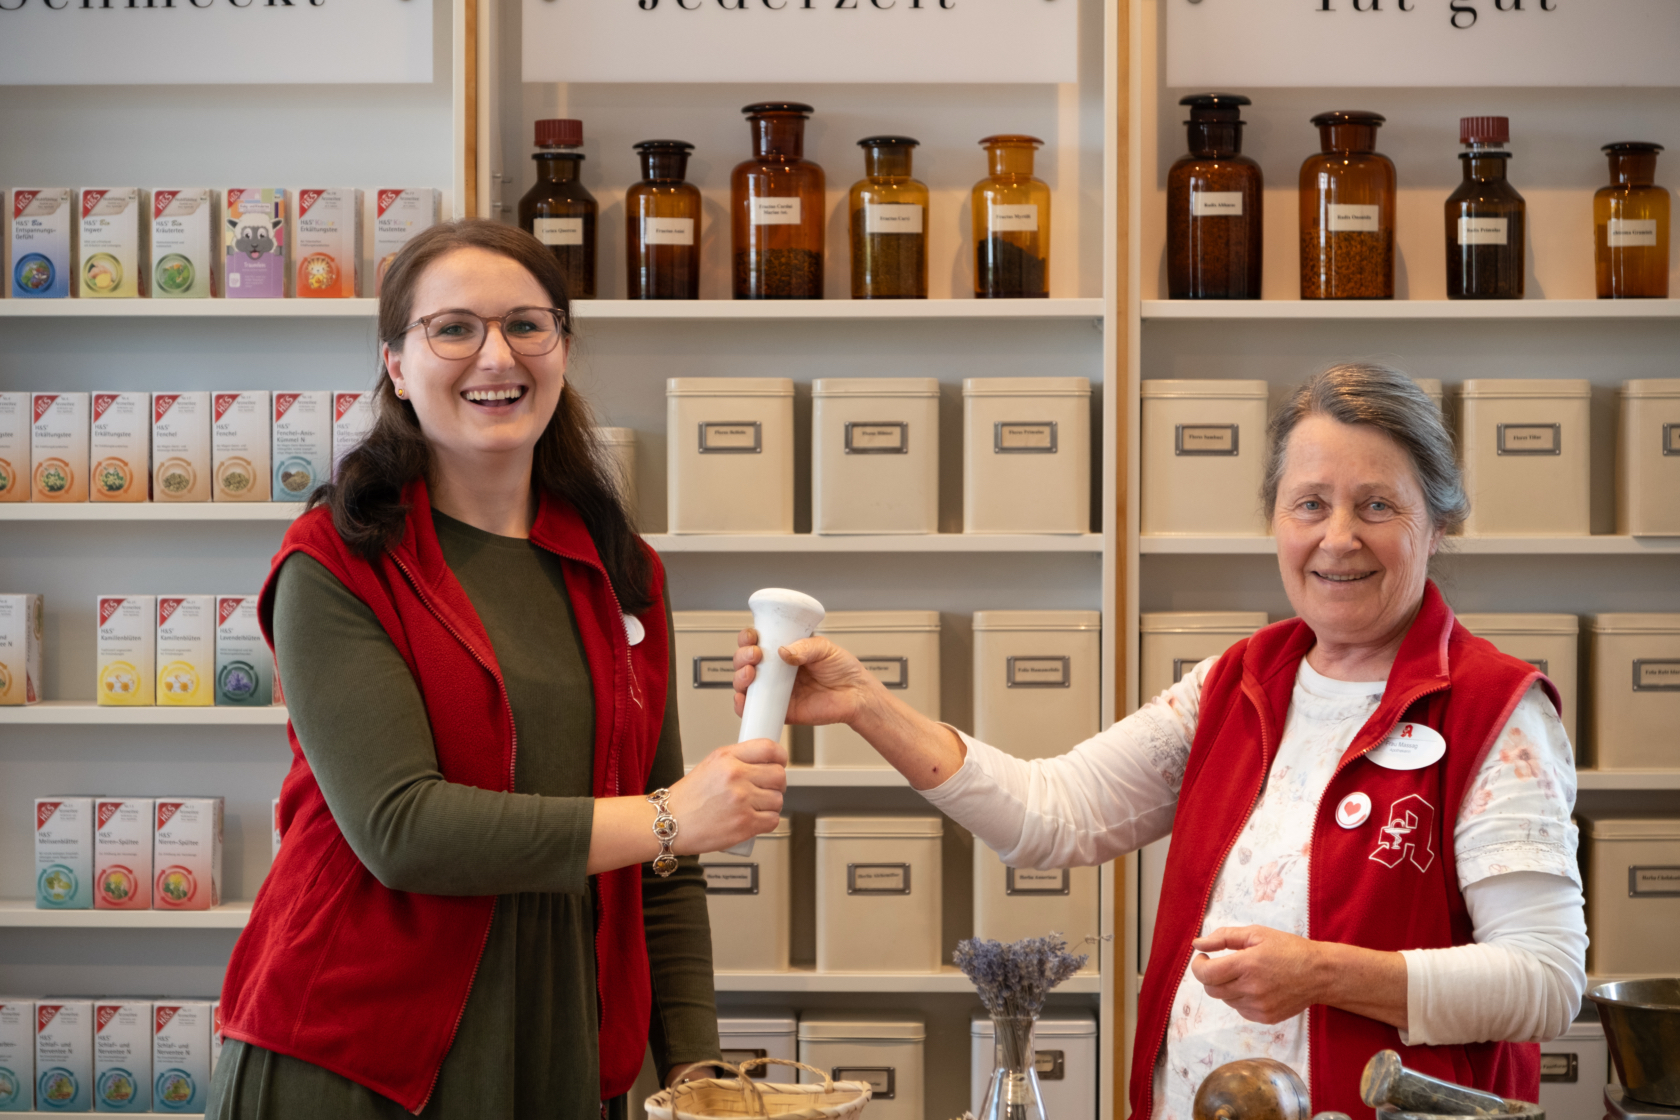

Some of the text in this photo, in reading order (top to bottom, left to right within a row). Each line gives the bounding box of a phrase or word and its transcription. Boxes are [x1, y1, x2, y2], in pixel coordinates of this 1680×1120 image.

[17, 192, 33, 210] H&S
[85, 192, 101, 210] H&S
[156, 192, 173, 210] H&S
[229, 190, 240, 203] H&S
[302, 191, 318, 209] H&S
[380, 191, 396, 209] H&S
[36, 397, 55, 415] H&S
[96, 396, 112, 414] H&S
[158, 397, 174, 414] H&S
[217, 396, 233, 414] H&S
[278, 396, 293, 413] H&S
[338, 396, 354, 413] H&S
[102, 600, 118, 618] H&S
[161, 600, 177, 618] H&S
[221, 600, 237, 618] H&S
[39, 804, 55, 822] H&S
[100, 804, 116, 822] H&S
[161, 804, 175, 822] H&S
[40, 1008, 55, 1025] H&S
[99, 1007, 114, 1025] H&S
[158, 1008, 173, 1026] H&S
